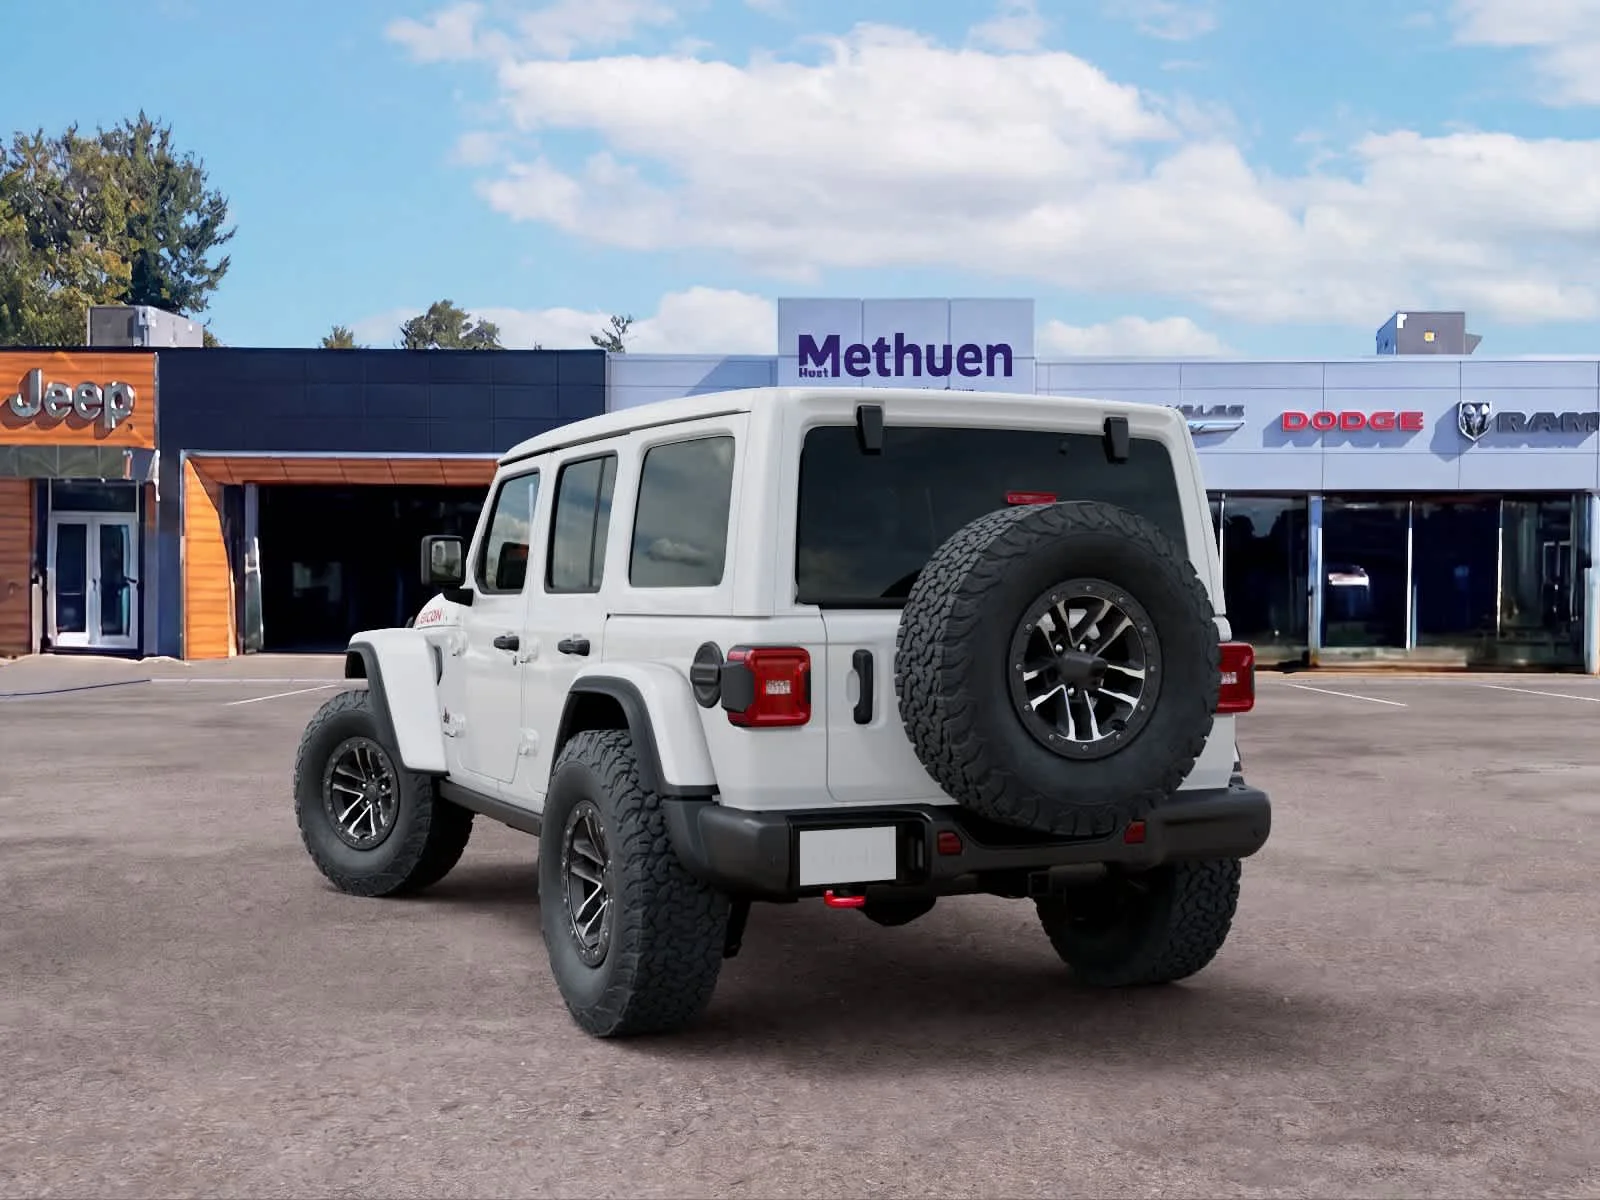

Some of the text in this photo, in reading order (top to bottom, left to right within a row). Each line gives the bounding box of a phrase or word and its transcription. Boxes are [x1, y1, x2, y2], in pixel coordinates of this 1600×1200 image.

[798, 332, 1013, 378] Methuen
[9, 367, 136, 430] Jeep
[1282, 411, 1424, 432] DODGE
[1496, 411, 1600, 433] RAM
